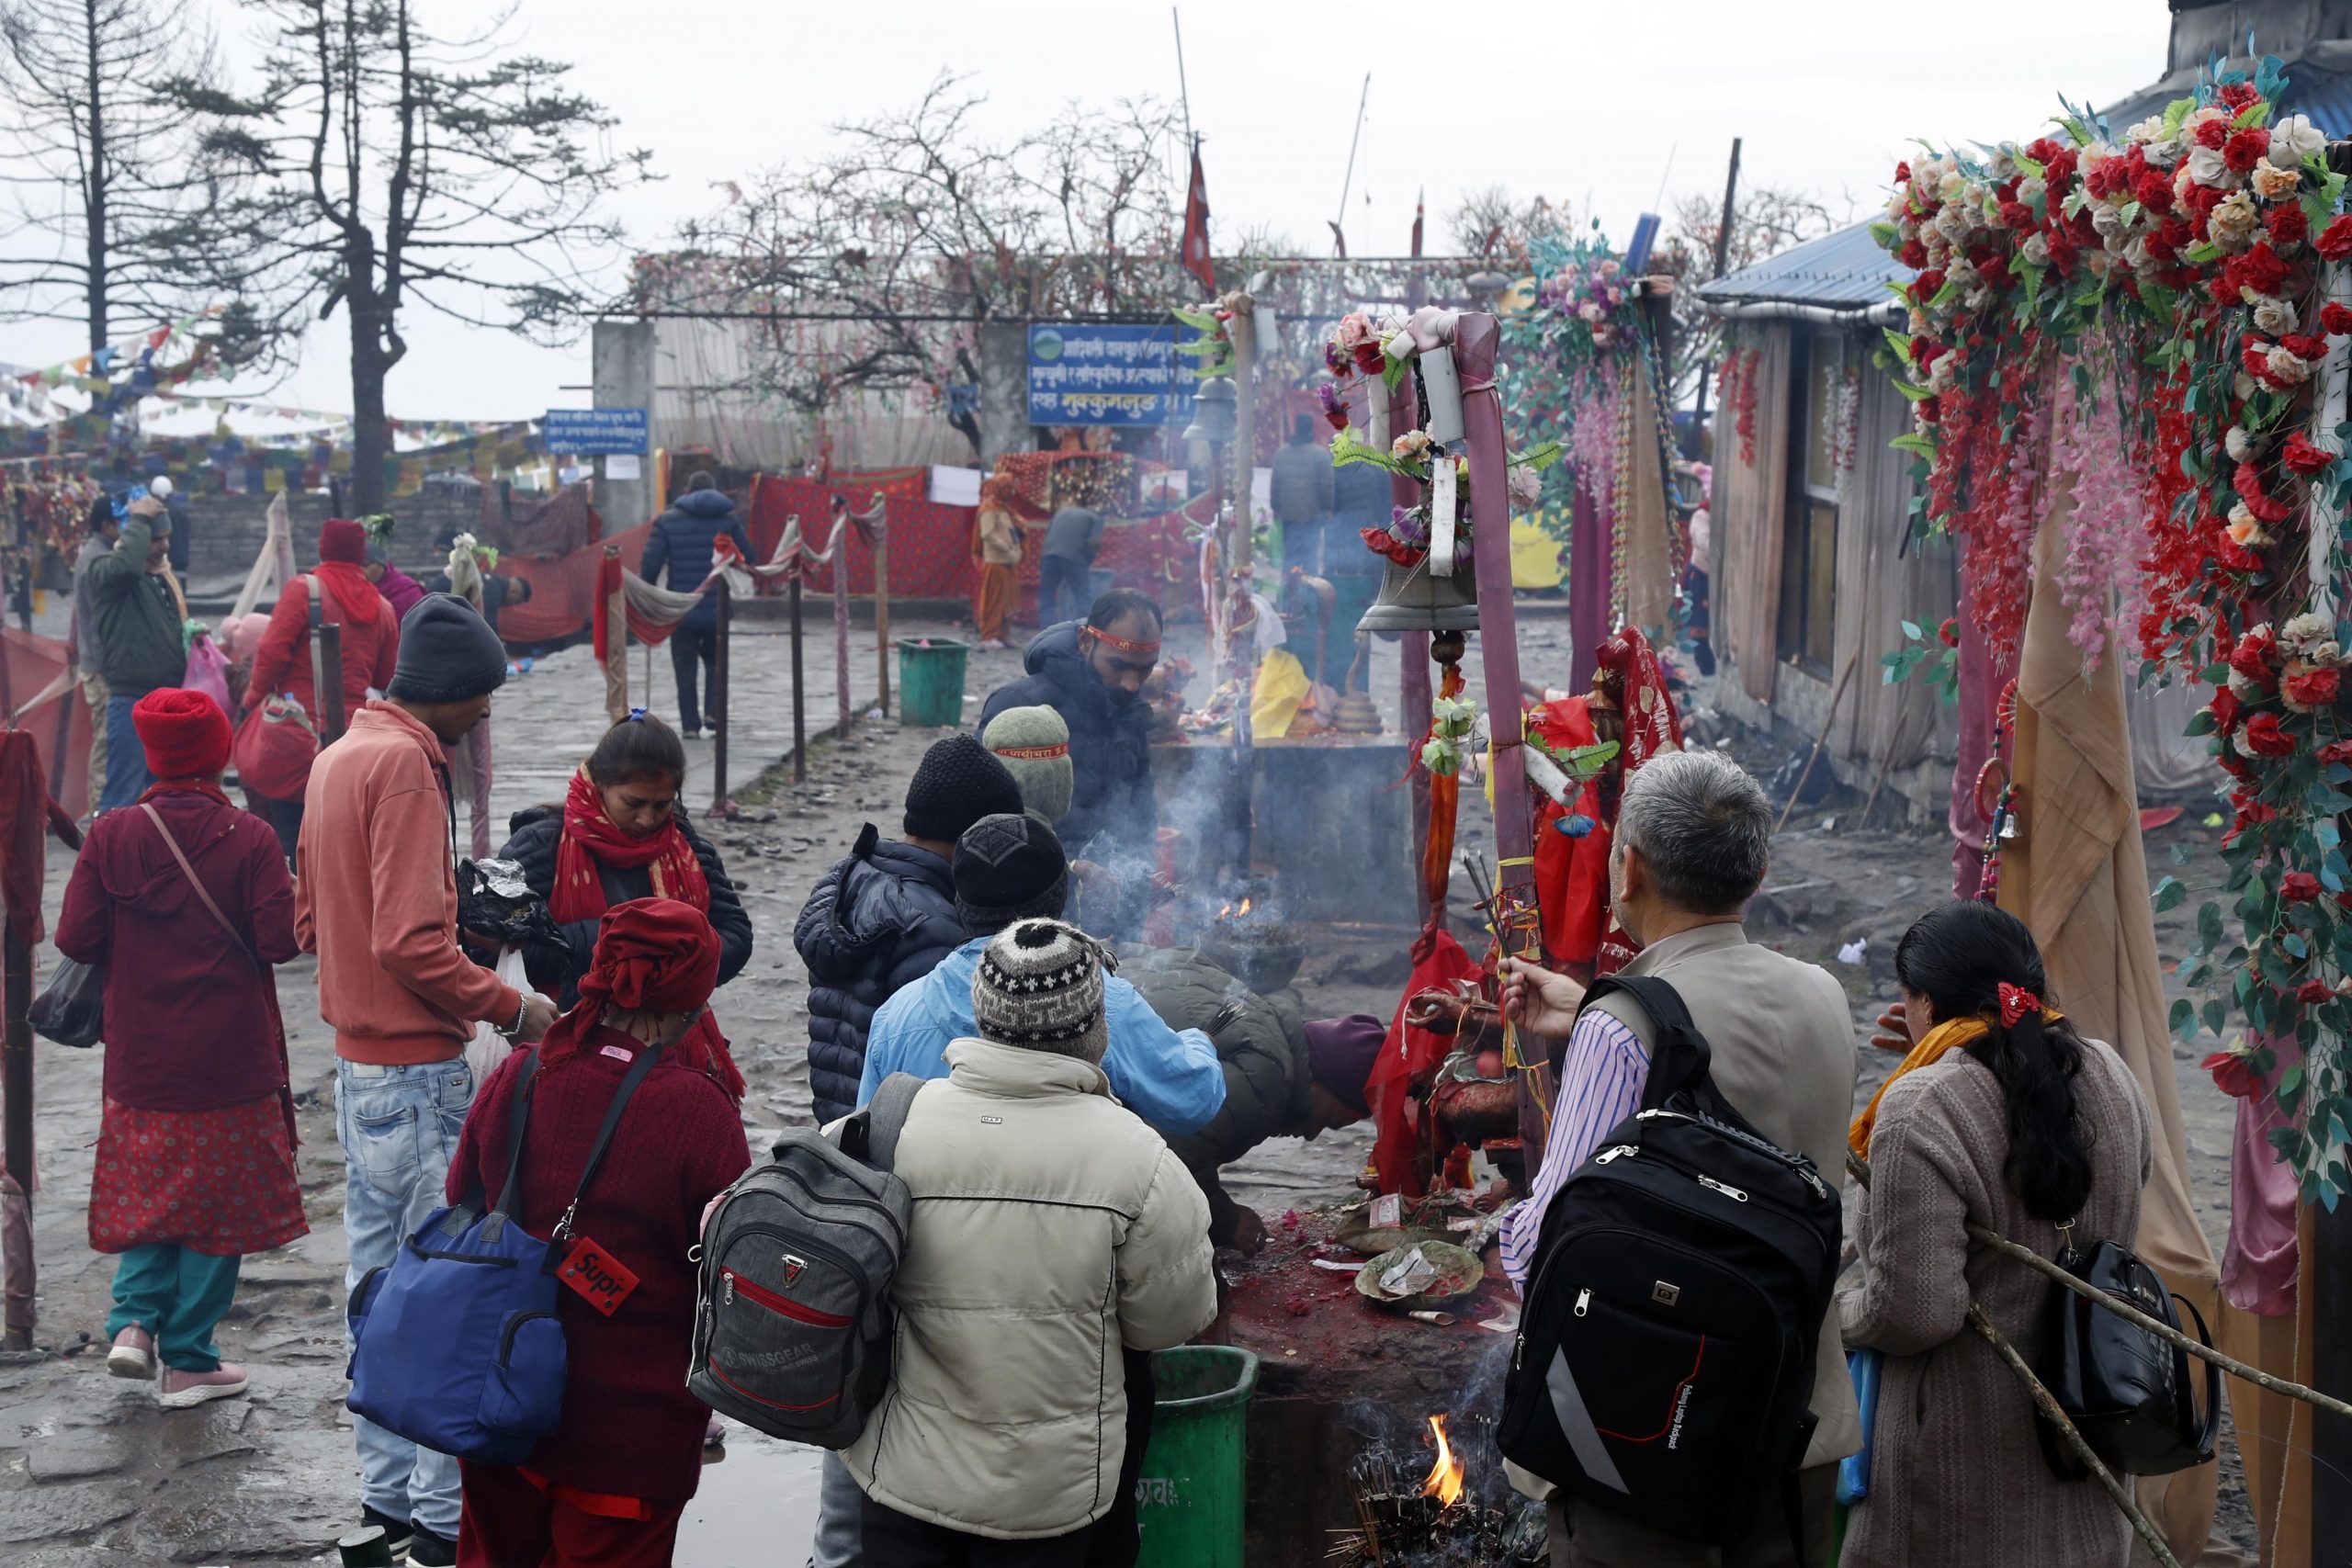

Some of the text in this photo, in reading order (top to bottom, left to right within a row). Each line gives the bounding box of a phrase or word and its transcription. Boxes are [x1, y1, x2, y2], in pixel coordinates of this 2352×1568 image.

[573, 1252, 625, 1298] Supr
[738, 1343, 815, 1368] SWISSGEAR
[1673, 1404, 1688, 1424] Laptop
[1668, 1424, 1682, 1450] Backpack
